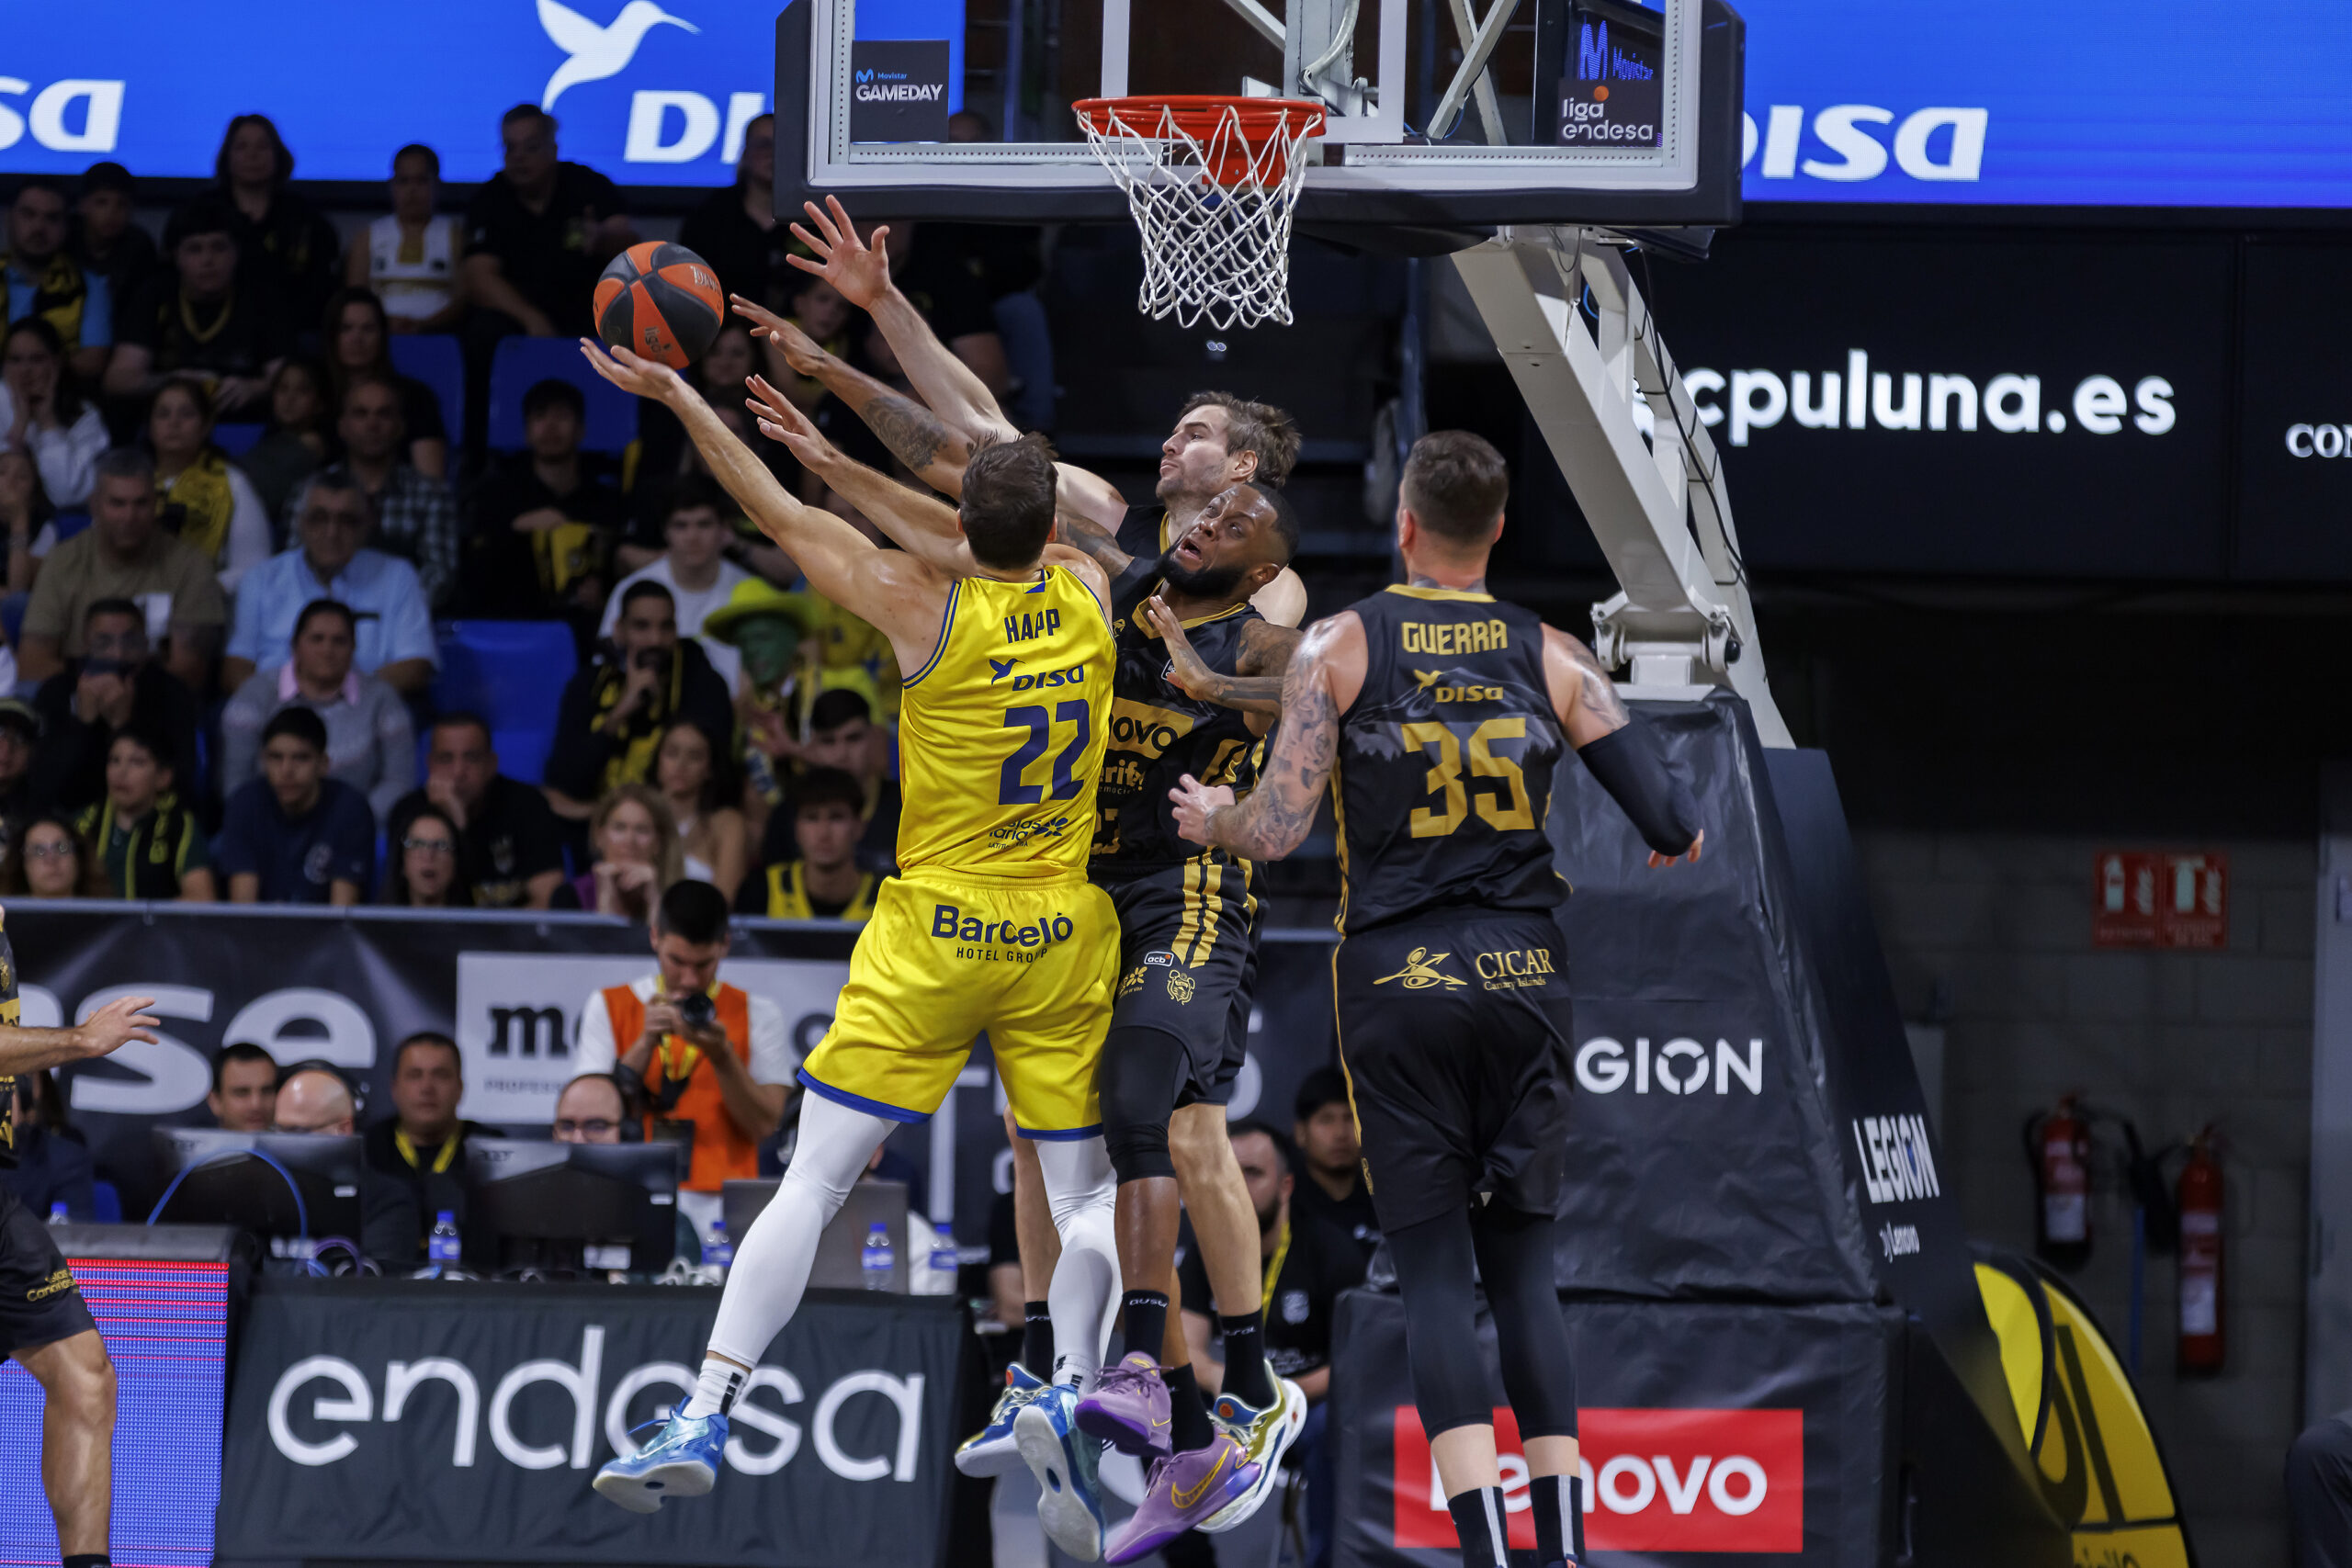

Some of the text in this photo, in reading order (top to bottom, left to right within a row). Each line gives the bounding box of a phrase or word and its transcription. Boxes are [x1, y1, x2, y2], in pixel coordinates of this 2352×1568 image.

[877, 72, 908, 80] Movistar
[855, 84, 944, 102] GAMEDAY
[1563, 97, 1605, 121] liga
[1563, 119, 1654, 141] endesa
[1004, 608, 1061, 643] HAPP
[1401, 619, 1509, 656] GUERRA
[1108, 714, 1179, 752] ovo
[998, 698, 1091, 806] 22
[1401, 716, 1536, 839] 35
[956, 947, 999, 962] HOTEL
[1147, 954, 1167, 964] acb
[1476, 948, 1555, 979] CICAR
[1484, 976, 1546, 991] Canary Islands
[1576, 1036, 1763, 1095] GION
[1852, 1113, 1940, 1204] LEGION
